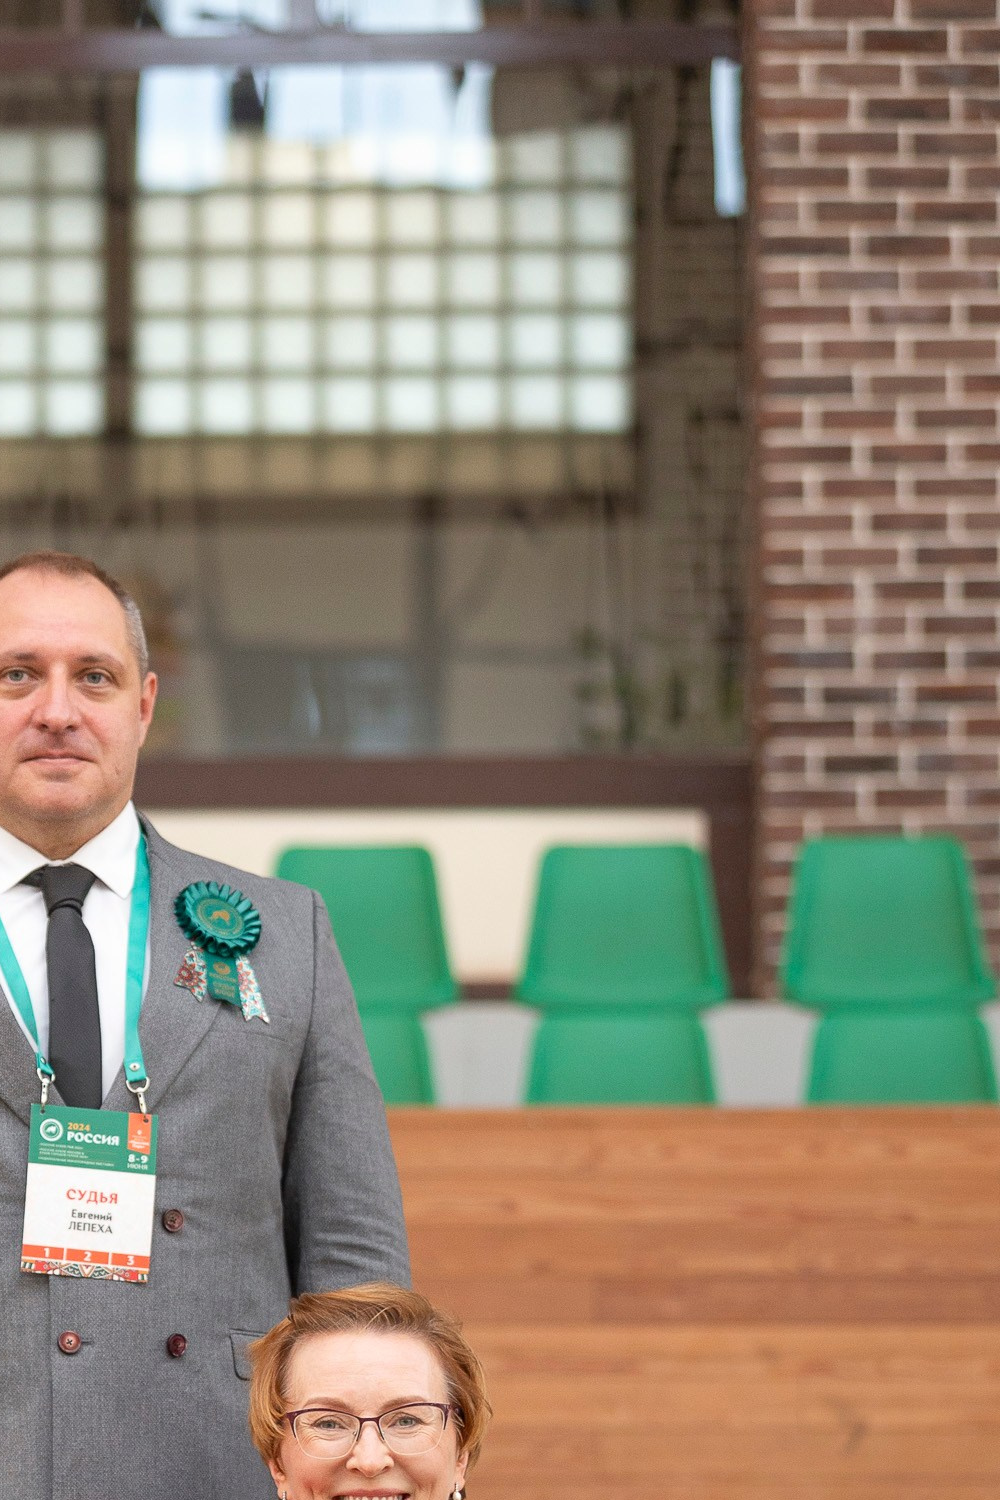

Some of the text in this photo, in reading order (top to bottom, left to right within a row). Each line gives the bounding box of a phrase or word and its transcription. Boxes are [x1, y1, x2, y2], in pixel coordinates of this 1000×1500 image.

[67, 1122, 90, 1132] 2024
[67, 1131, 120, 1146] РОССИЯ
[127, 1163, 148, 1171] ИЮНЯ
[66, 1188, 118, 1204] СУДЬЯ
[71, 1209, 112, 1222] Евгений
[68, 1221, 113, 1234] ЛЕПЕХА
[43, 1247, 135, 1266] 1 2 3
